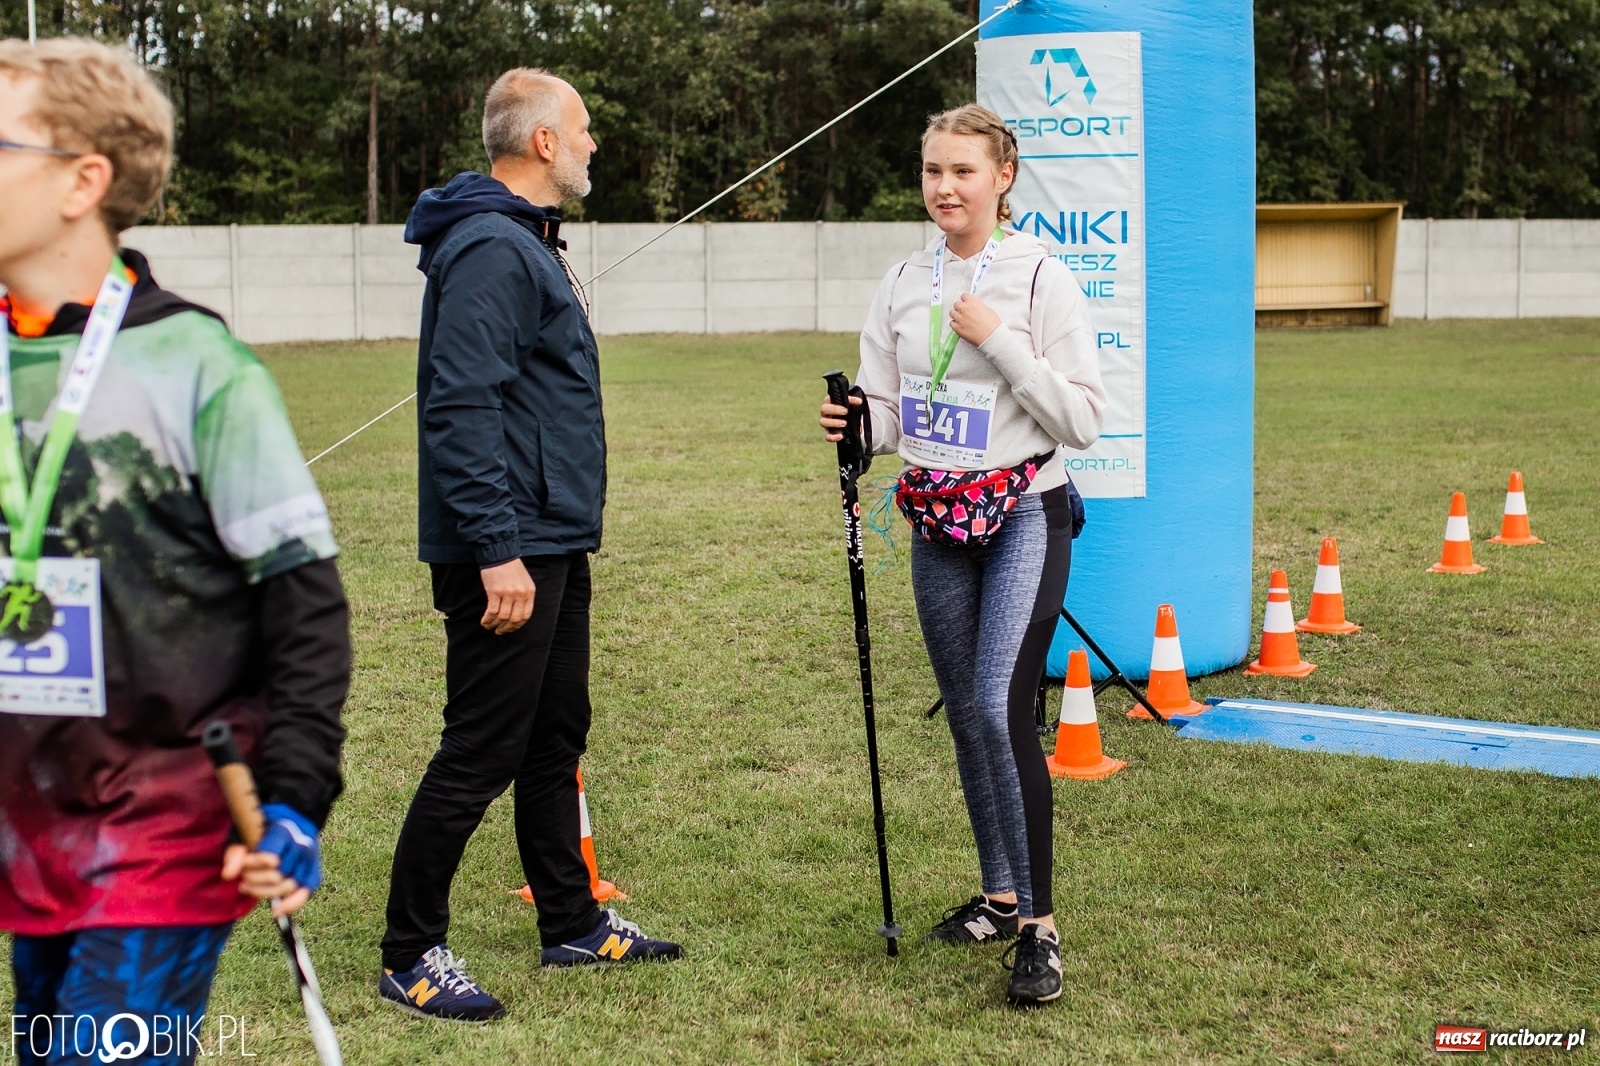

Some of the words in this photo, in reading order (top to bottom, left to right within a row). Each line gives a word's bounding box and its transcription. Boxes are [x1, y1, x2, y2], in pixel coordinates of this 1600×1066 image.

[1049, 254, 1117, 271] ESZ
[914, 403, 970, 445] 341
[964, 915, 998, 941] N
[597, 933, 634, 960] N
[407, 976, 440, 1007] N
